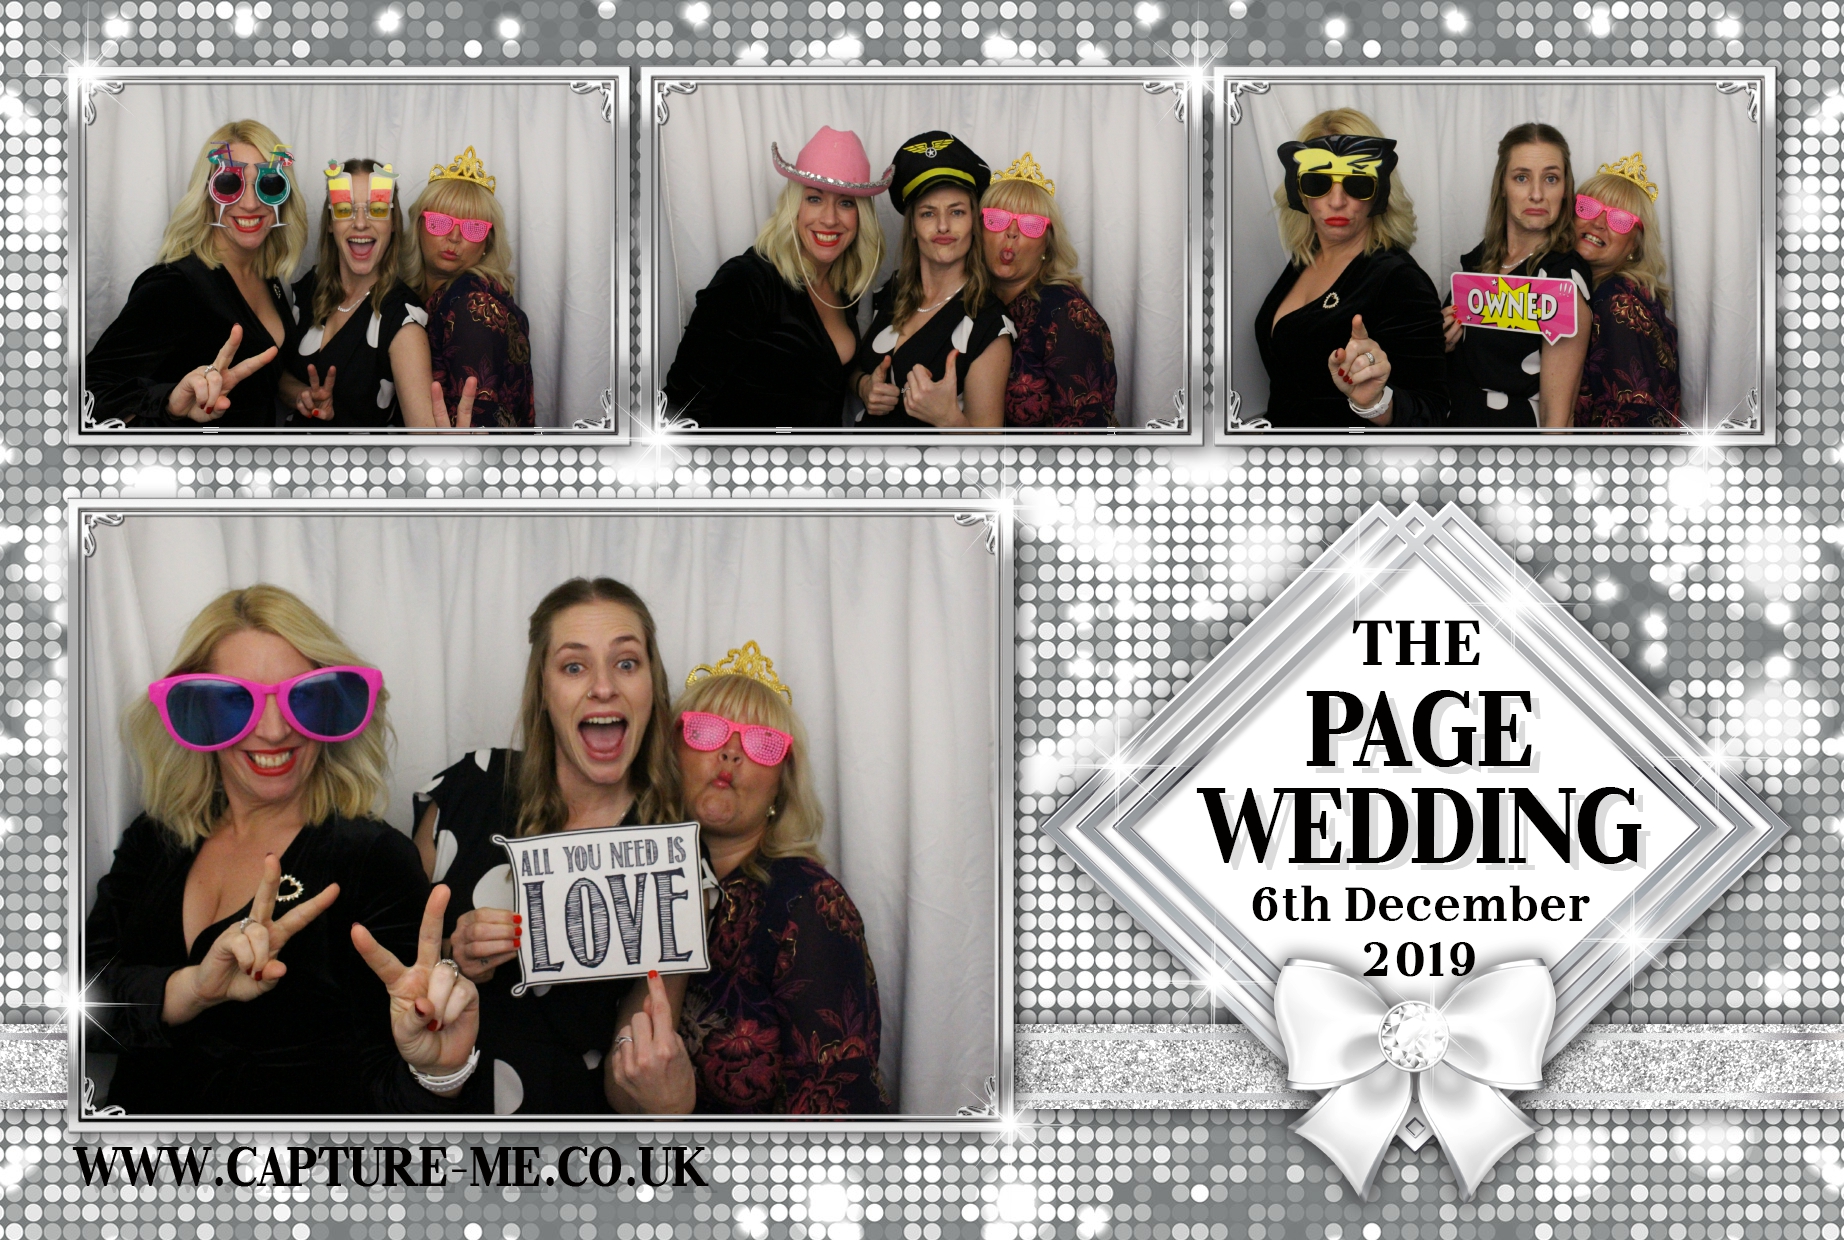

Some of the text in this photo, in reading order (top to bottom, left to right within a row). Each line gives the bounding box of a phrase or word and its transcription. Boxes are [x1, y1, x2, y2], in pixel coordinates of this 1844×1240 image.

[1467, 288, 1558, 321] OWNED
[521, 836, 687, 877] ALL YOU NEED IS
[522, 867, 693, 973] LOVE
